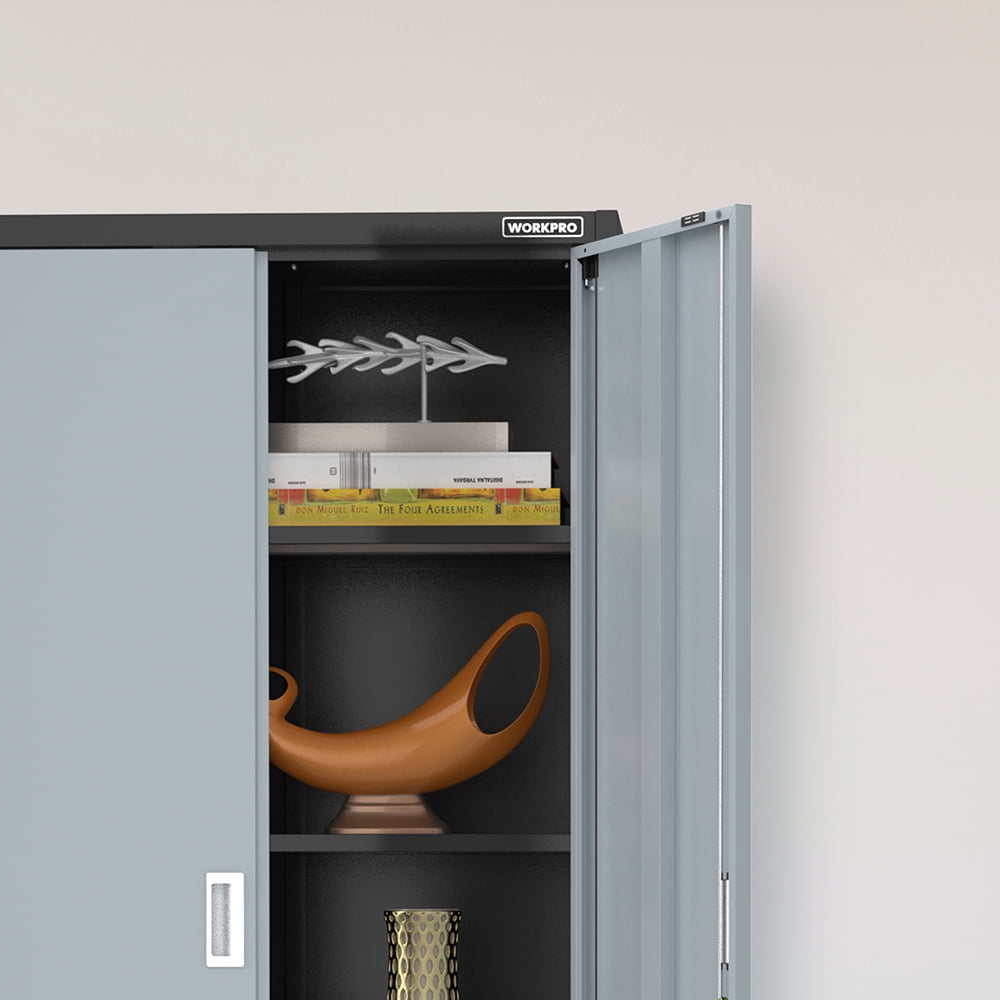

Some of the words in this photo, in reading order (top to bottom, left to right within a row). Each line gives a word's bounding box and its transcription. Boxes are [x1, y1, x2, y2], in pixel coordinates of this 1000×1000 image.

[507, 222, 578, 234] WORKPRO
[317, 504, 346, 514] MIGUEL
[350, 505, 369, 513] RUIZ
[378, 504, 395, 514] THE
[398, 504, 422, 514] FOUR
[426, 504, 484, 514] AGREEMENTS
